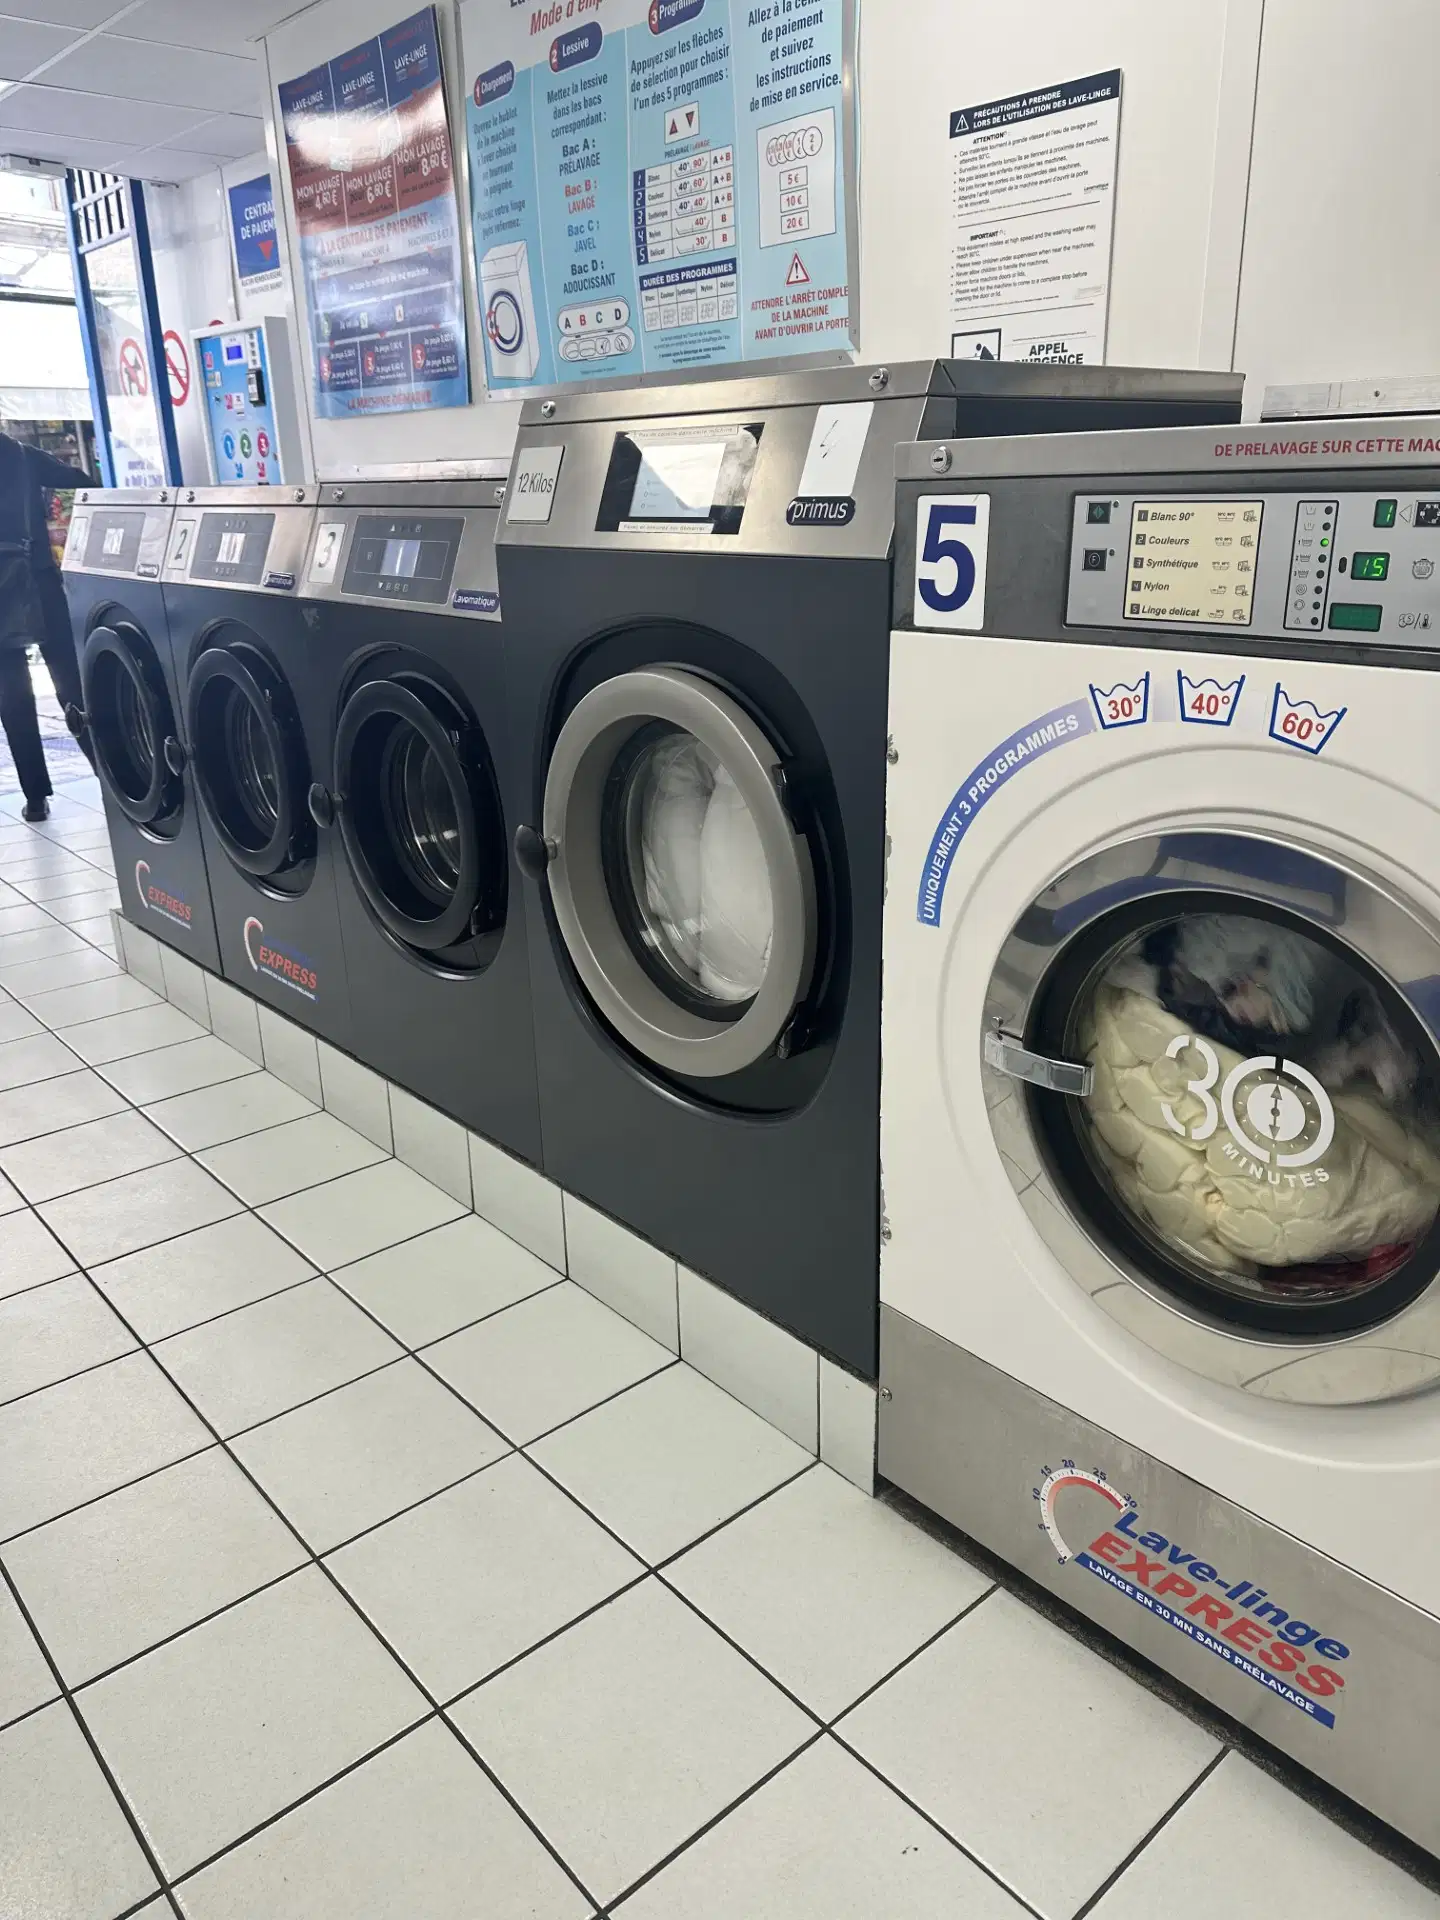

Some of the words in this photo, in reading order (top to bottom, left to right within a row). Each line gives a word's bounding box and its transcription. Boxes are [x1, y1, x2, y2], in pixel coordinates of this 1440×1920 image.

[530, 2, 562, 35] Mode
[651, 10, 658, 25] 3
[748, 7, 771, 28] Allez
[774, 1, 780, 17] à
[761, 26, 773, 43] de
[775, 9, 823, 42] paiement
[394, 43, 428, 70] LAVE-LINGE
[551, 49, 558, 63] 2
[562, 37, 590, 58] Lessive
[630, 52, 663, 76] Appuyez
[664, 46, 677, 60] sur
[678, 40, 691, 55] les
[692, 26, 724, 49] flèches
[770, 46, 780, 62] et
[781, 37, 814, 58] suivez
[630, 79, 641, 93] de
[643, 66, 678, 89] sélection
[679, 58, 698, 78] pour
[700, 43, 730, 67] choisir
[756, 73, 770, 89] les
[772, 53, 832, 84] instructions
[341, 71, 376, 95] LAVE-LINGE
[481, 70, 512, 94] Chargement
[547, 86, 570, 105] Mettez
[572, 82, 579, 95] la
[580, 73, 608, 92] lessive
[634, 97, 650, 111] l'un
[651, 92, 666, 106] des
[666, 86, 672, 100] 5
[673, 69, 724, 101] programmes
[750, 97, 760, 112] de
[761, 90, 783, 108] mise
[785, 85, 797, 100] en
[799, 73, 842, 95] service.
[292, 89, 324, 112] LAVE-LINGE
[553, 106, 570, 121] dans
[571, 100, 582, 113] les
[584, 94, 602, 109] bacs
[973, 100, 1020, 119] PRÉCAUTIONS
[1021, 98, 1028, 108] À
[1028, 90, 1062, 105] PRENDRE
[973, 119, 991, 129] LORS
[992, 116, 1001, 125] DE
[1002, 103, 1052, 122] L'UTILISATION
[1052, 99, 1067, 109] DES
[1068, 87, 1112, 105] LAVE-LINGE
[551, 111, 603, 139] correspondant
[397, 148, 415, 165] MON
[416, 135, 446, 157] LAVAGE
[562, 143, 580, 158] Bac
[582, 138, 590, 151] A
[559, 152, 601, 177] PRÉLAVAGE
[296, 184, 315, 200] MON
[315, 174, 341, 193] LAVAGE
[346, 175, 363, 193] MON
[364, 165, 393, 186] LAVAGE
[565, 182, 582, 198] Bac
[585, 179, 591, 192] B
[787, 173, 793, 185] 5
[794, 173, 800, 183] €
[568, 195, 595, 215] LAVAGE
[786, 195, 796, 207] 10
[797, 194, 802, 205] €
[241, 225, 252, 240] DE
[567, 222, 585, 237] Bac
[587, 219, 594, 232] C
[787, 217, 797, 229] 20
[798, 217, 803, 227] €
[574, 237, 597, 254] JAVEL
[571, 261, 589, 276] Bac
[591, 259, 599, 272] D
[643, 274, 665, 288] DURÉE
[666, 272, 680, 283] DES
[680, 263, 733, 281] PROGRAMMES
[563, 272, 616, 295] ADOUCISSANT
[751, 296, 784, 311] ATTENDRE
[785, 289, 815, 306] L'ARRÊT
[564, 317, 572, 330] A
[579, 314, 587, 327] B
[596, 311, 603, 324] C
[614, 308, 622, 321] D
[771, 311, 781, 323] DE
[782, 310, 792, 321] LA
[793, 304, 829, 320] MACHINE
[755, 327, 777, 340] AVANT
[778, 322, 814, 337] D'OUVRIR
[815, 320, 824, 332] LA
[825, 317, 849, 329] PORTE
[1029, 341, 1069, 357] APPEL
[1214, 443, 1233, 457] DE
[1235, 440, 1318, 456] PRELAVAGE
[1321, 440, 1352, 454] SUR
[1356, 438, 1405, 453] CETTE
[518, 472, 530, 493] 12
[529, 472, 554, 493] Kilos
[791, 498, 849, 524] primus
[1150, 511, 1177, 521] Blanc
[1179, 511, 1195, 521] 90°
[1386, 504, 1394, 522] 1
[174, 528, 188, 560] 2
[318, 531, 337, 568] 3
[1148, 536, 1190, 546] Couleurs
[918, 504, 977, 612] 5
[1146, 558, 1199, 570] Synthétique
[1363, 557, 1385, 577] 15
[1143, 581, 1170, 592] Nylon
[454, 595, 496, 608] Lavomatique
[1141, 605, 1167, 617] Linge
[1108, 694, 1141, 720] 30°
[1191, 692, 1231, 716] 40°
[1282, 712, 1326, 740] 60°
[923, 811, 963, 919] UNIQUEMENT
[958, 800, 972, 815] 3
[967, 714, 1079, 803] PROGRAMMES
[148, 885, 192, 921] EXPRESS
[259, 945, 318, 990] EXPRESS
[1160, 1034, 1335, 1167] 30
[1222, 1141, 1330, 1188] MINUTES
[1040, 1465, 1053, 1477] 15
[1061, 1459, 1075, 1469] 20
[1093, 1467, 1107, 1481] 25
[1032, 1487, 1041, 1501] 10
[1123, 1493, 1137, 1508] 30
[1038, 1523, 1046, 1531] 5
[1114, 1510, 1350, 1661] Lave-linge
[1087, 1531, 1345, 1697] EXPRESS
[1089, 1559, 1134, 1596] LAVAGE
[1136, 1590, 1154, 1608] EN
[1155, 1604, 1171, 1620] 30
[1173, 1615, 1194, 1634] MN
[1195, 1630, 1232, 1660] SANS
[1234, 1655, 1316, 1714] PRÉLAVAGE
